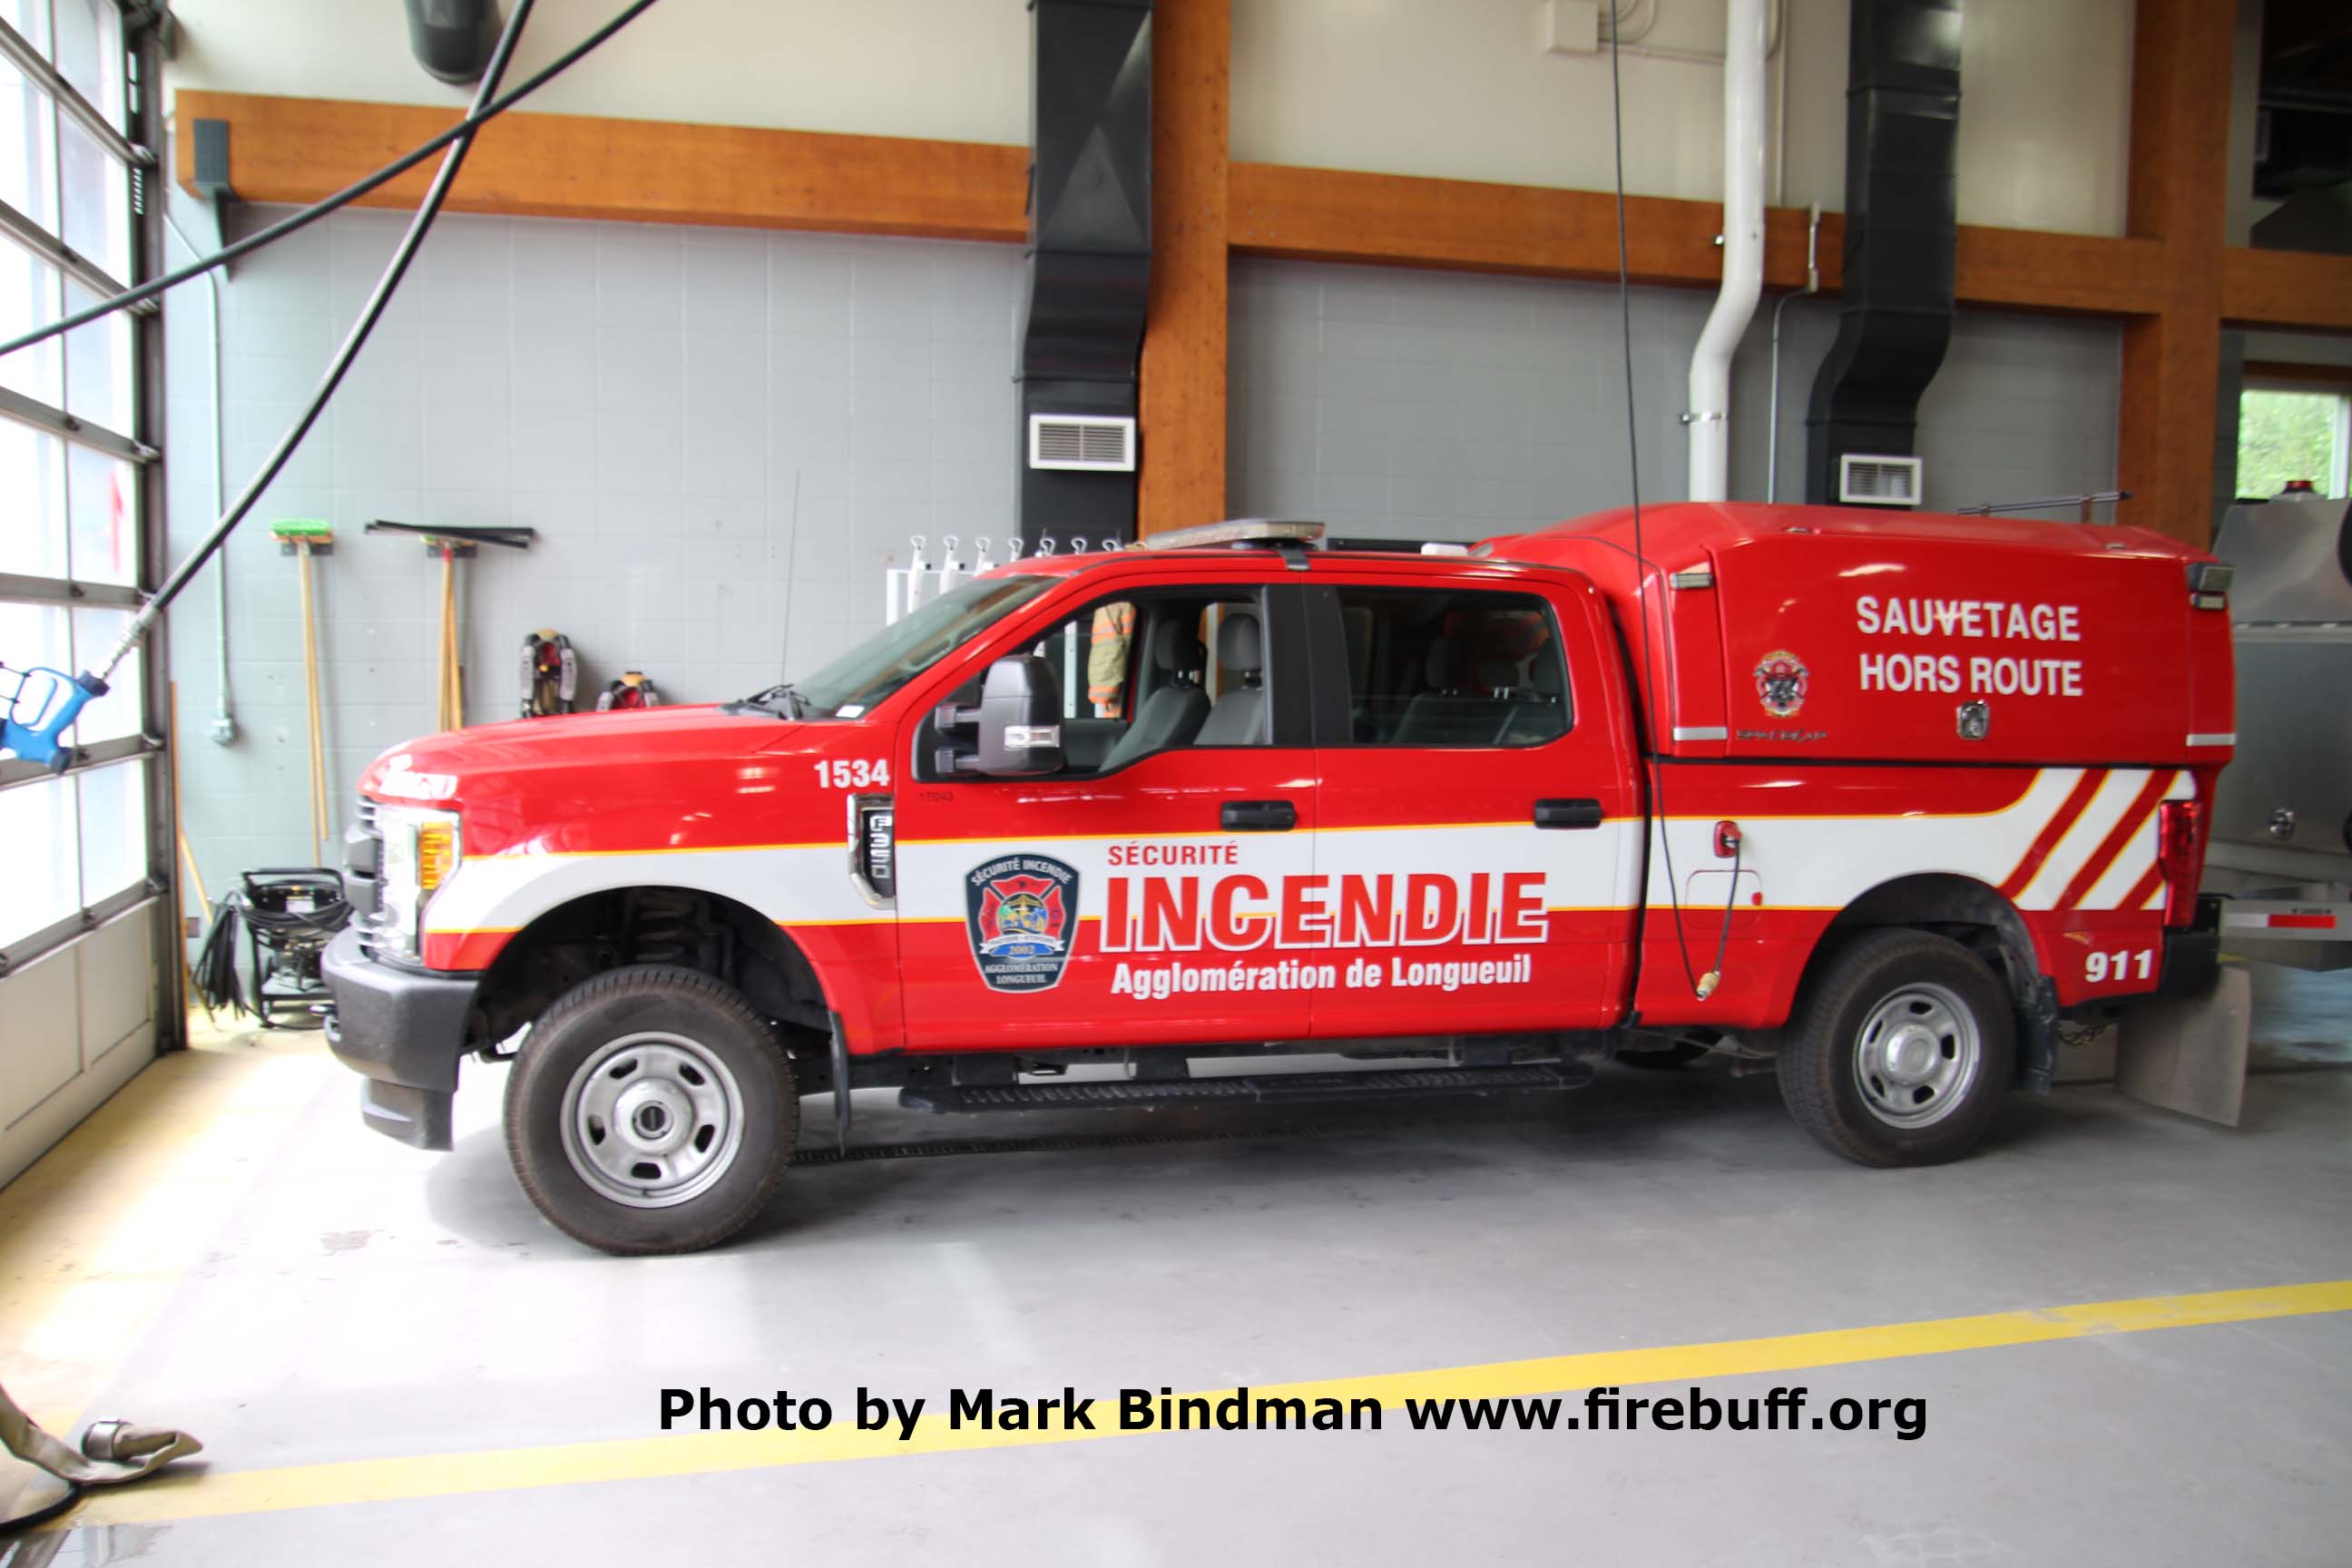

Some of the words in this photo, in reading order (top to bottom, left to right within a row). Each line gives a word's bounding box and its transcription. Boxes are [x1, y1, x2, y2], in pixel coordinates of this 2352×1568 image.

[1857, 595, 2080, 642] SAUVETAGE
[1859, 653, 1960, 693] HORS
[1970, 657, 2082, 697] ROUTE
[814, 759, 890, 789] 1534
[971, 857, 1021, 886] SÉCURITÉ
[1022, 858, 1073, 885] INCENDIE
[1107, 843, 1239, 866] SÉCURITÉ
[1099, 872, 1549, 953] INCENDIE
[1110, 958, 1337, 1001] Agglomération
[1345, 957, 1382, 988] de
[1391, 953, 1532, 993] Longueuil
[2085, 949, 2151, 983] 911
